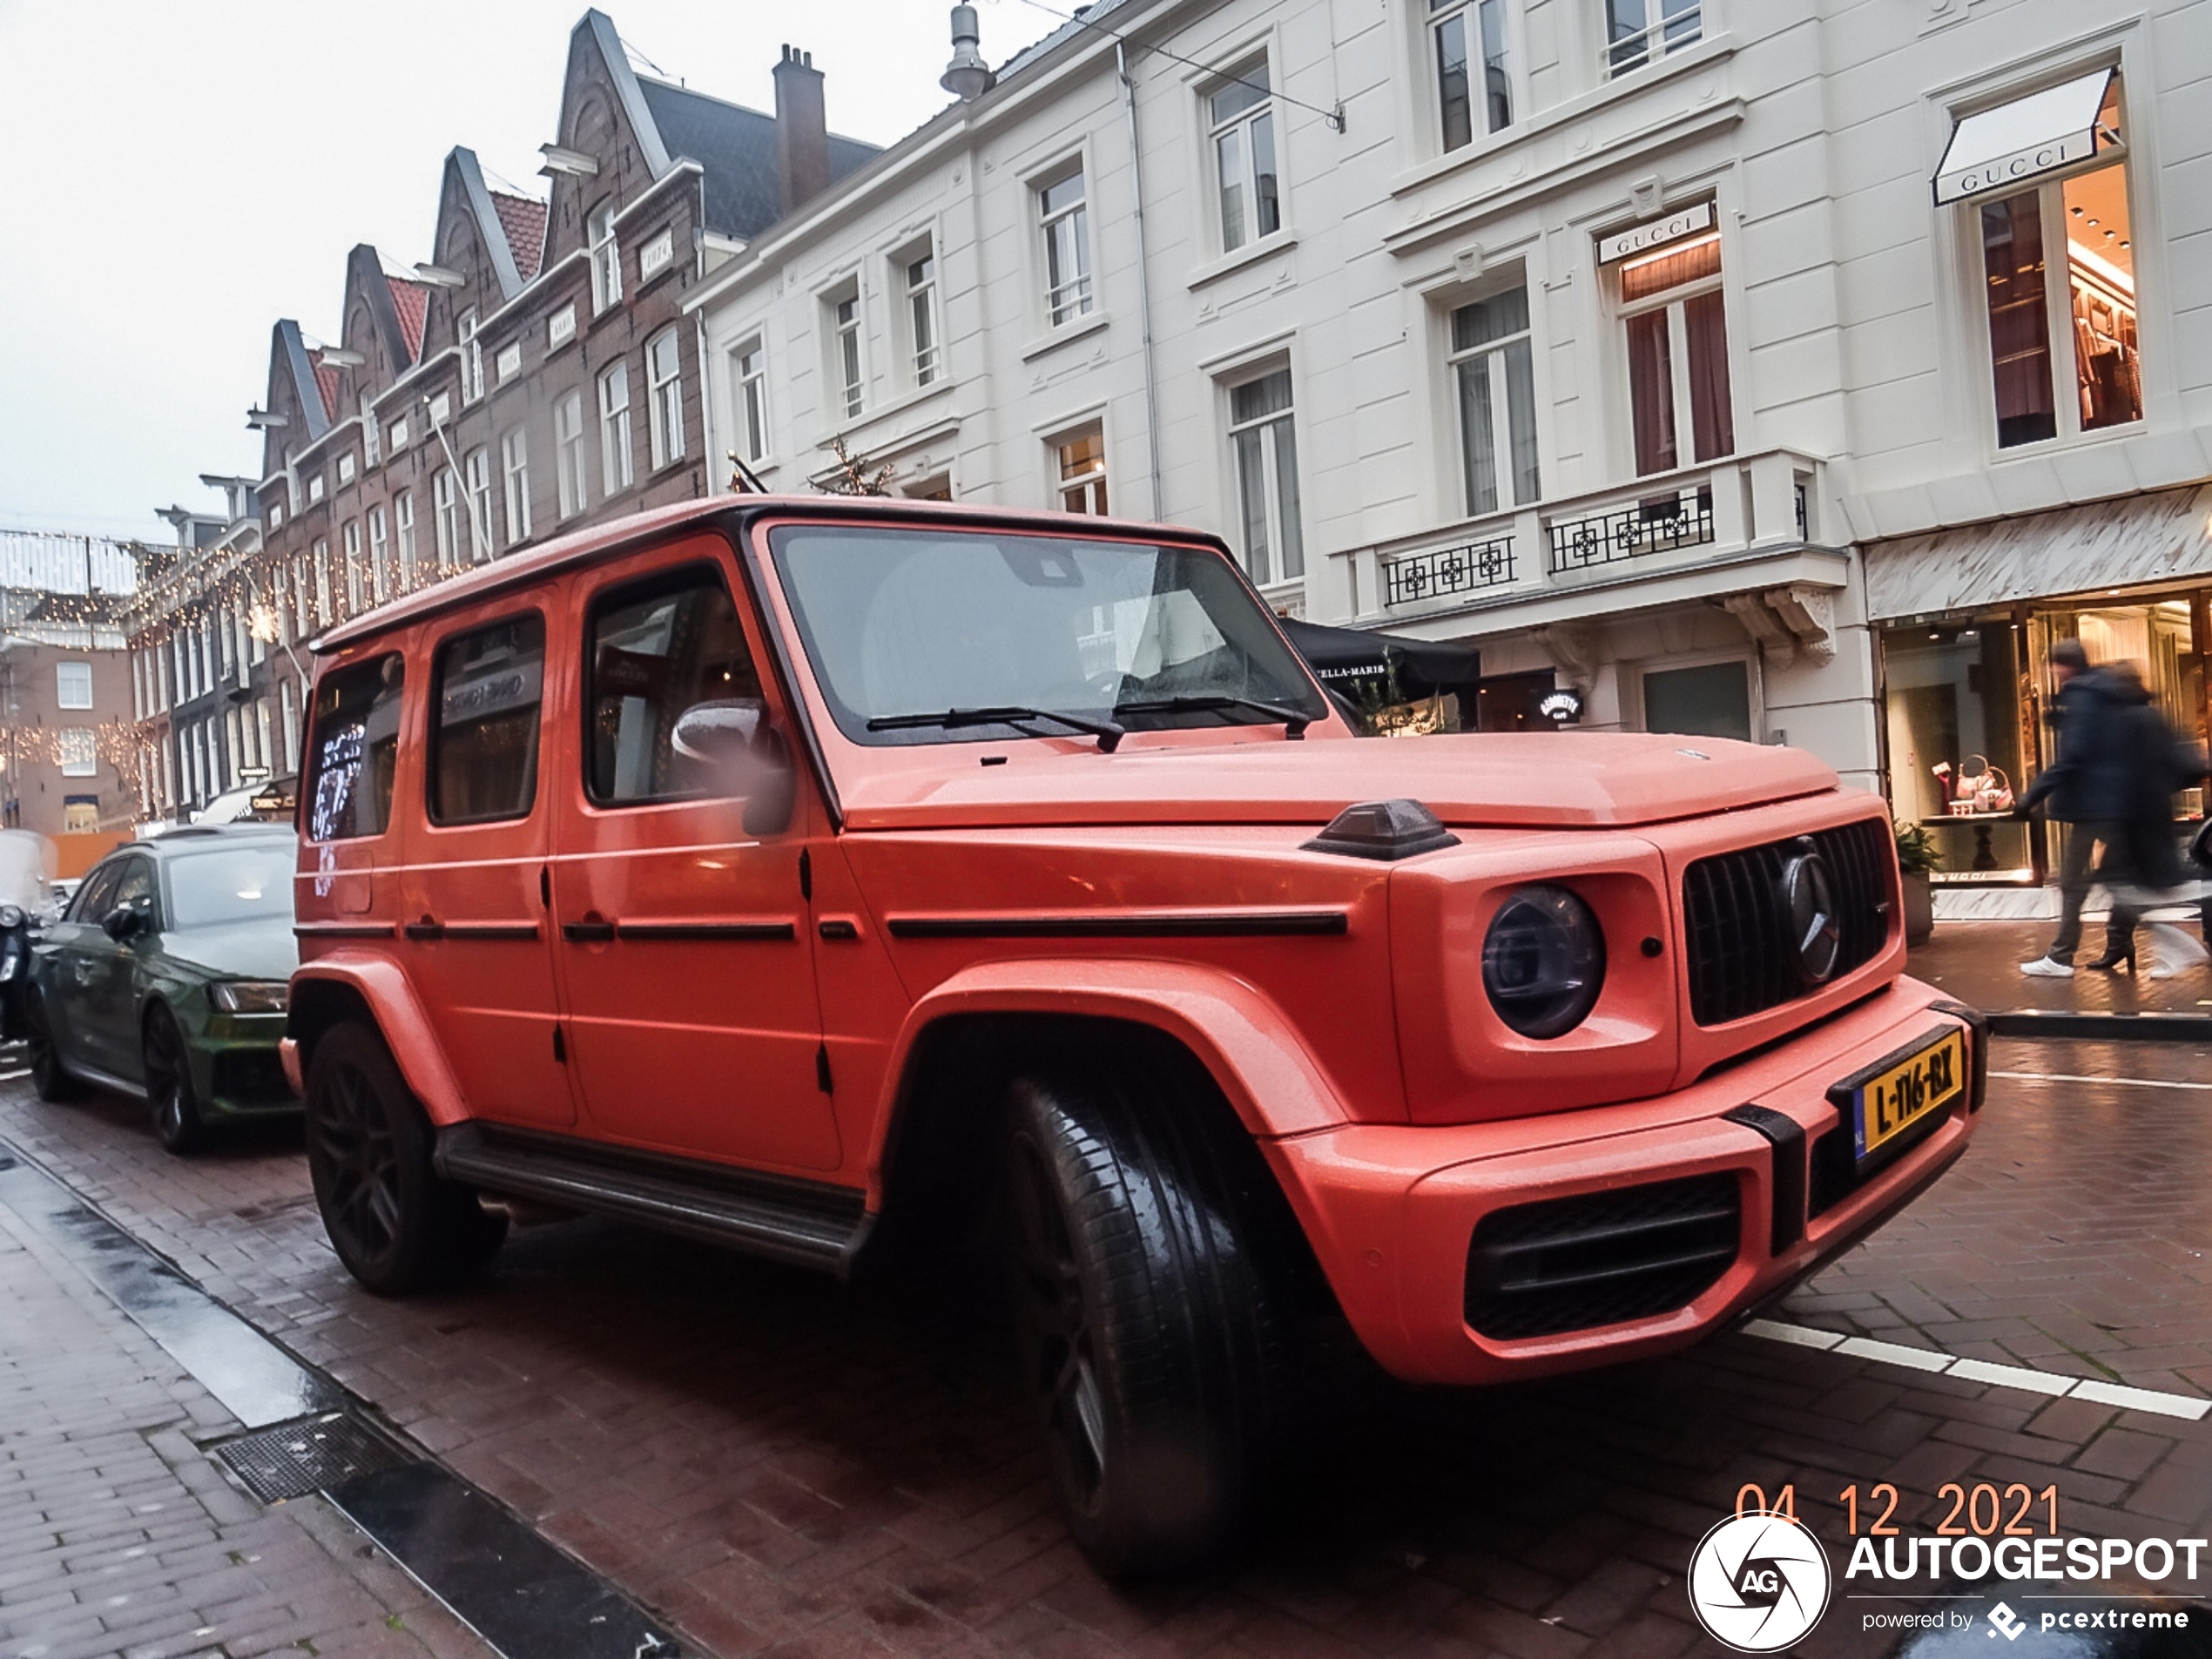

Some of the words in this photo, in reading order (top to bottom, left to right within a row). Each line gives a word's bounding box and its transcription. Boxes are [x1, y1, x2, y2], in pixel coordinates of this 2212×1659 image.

[1961, 145, 2065, 192] GUCCI
[1617, 218, 1690, 253] GUCCI
[1318, 664, 1385, 678] ELLA-MARIS
